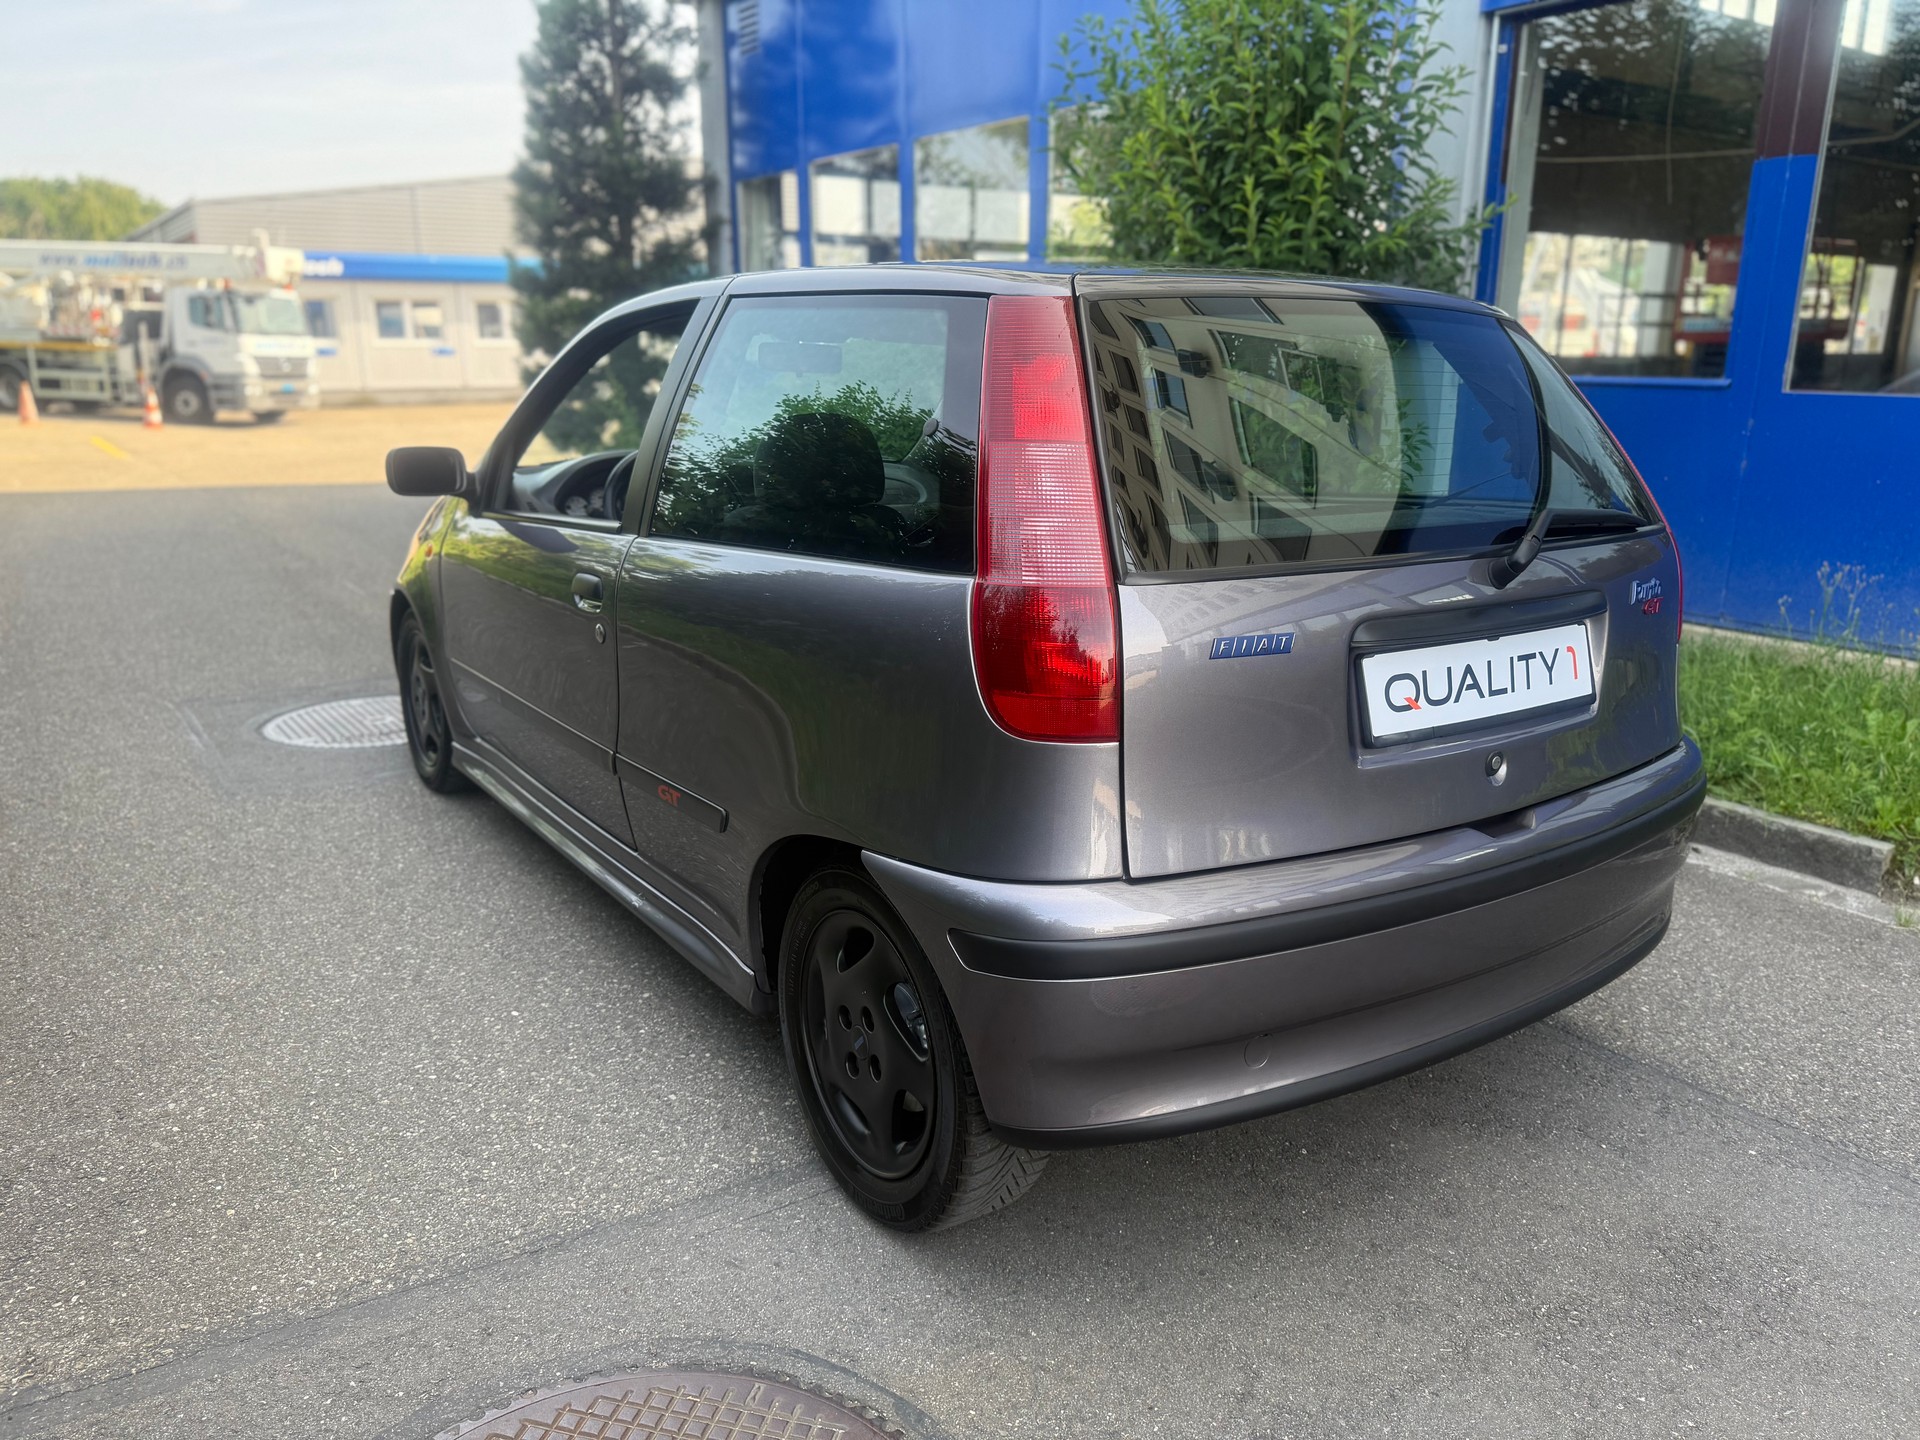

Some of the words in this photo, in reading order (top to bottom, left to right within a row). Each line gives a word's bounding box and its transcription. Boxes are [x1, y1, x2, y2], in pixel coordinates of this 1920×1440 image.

[1643, 597, 1664, 615] GT
[1218, 635, 1290, 656] FIAT
[657, 784, 681, 808] GT
